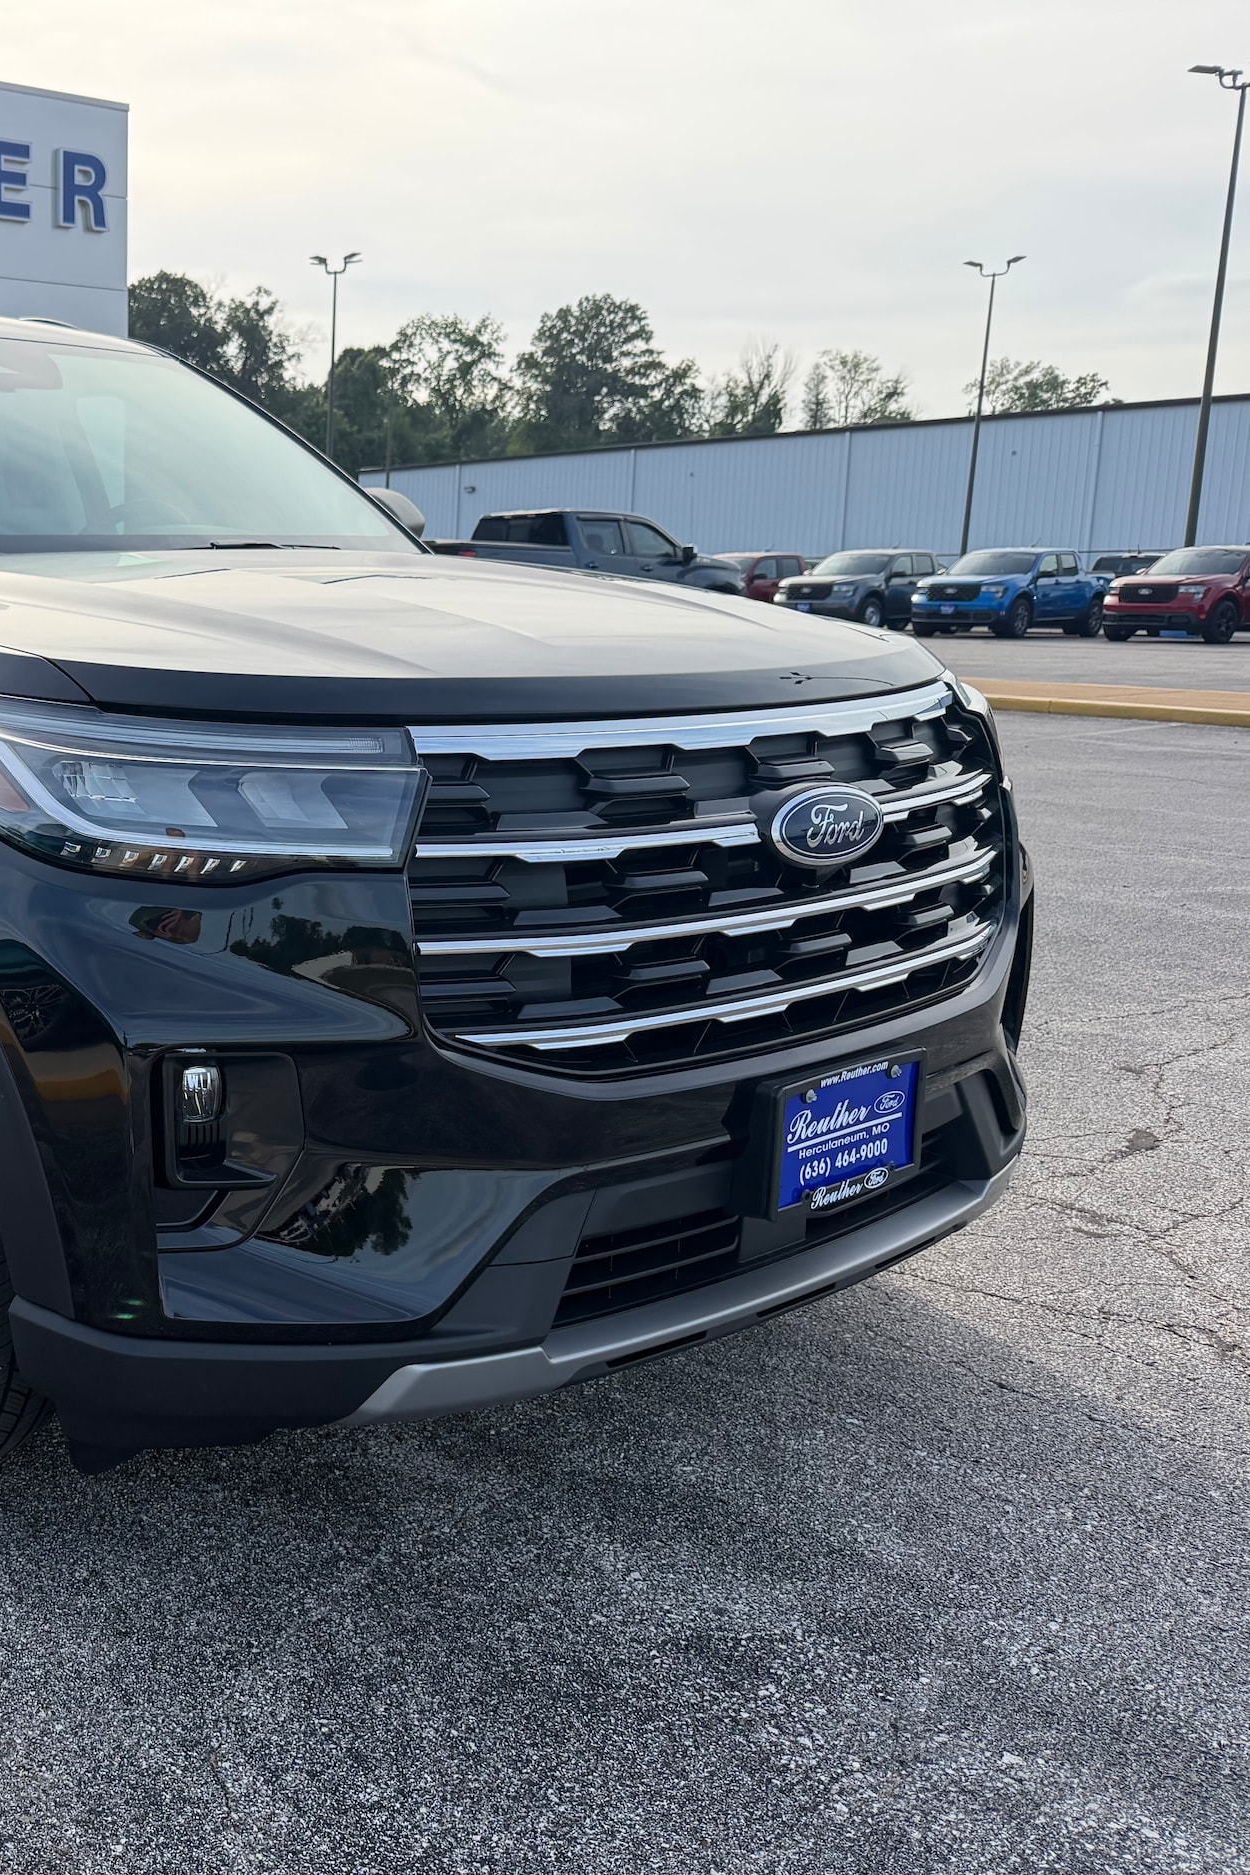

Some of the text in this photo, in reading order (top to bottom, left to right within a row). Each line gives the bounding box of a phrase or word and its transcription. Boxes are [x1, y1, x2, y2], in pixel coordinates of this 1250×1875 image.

[806, 803, 865, 848] Ford
[820, 1061, 889, 1088] www.Reuther.com
[787, 1099, 871, 1144] Reuther
[799, 1123, 890, 1160] Herculaneum, MO
[799, 1138, 888, 1186] (636) 464-9000
[810, 1178, 864, 1210] Reuther
